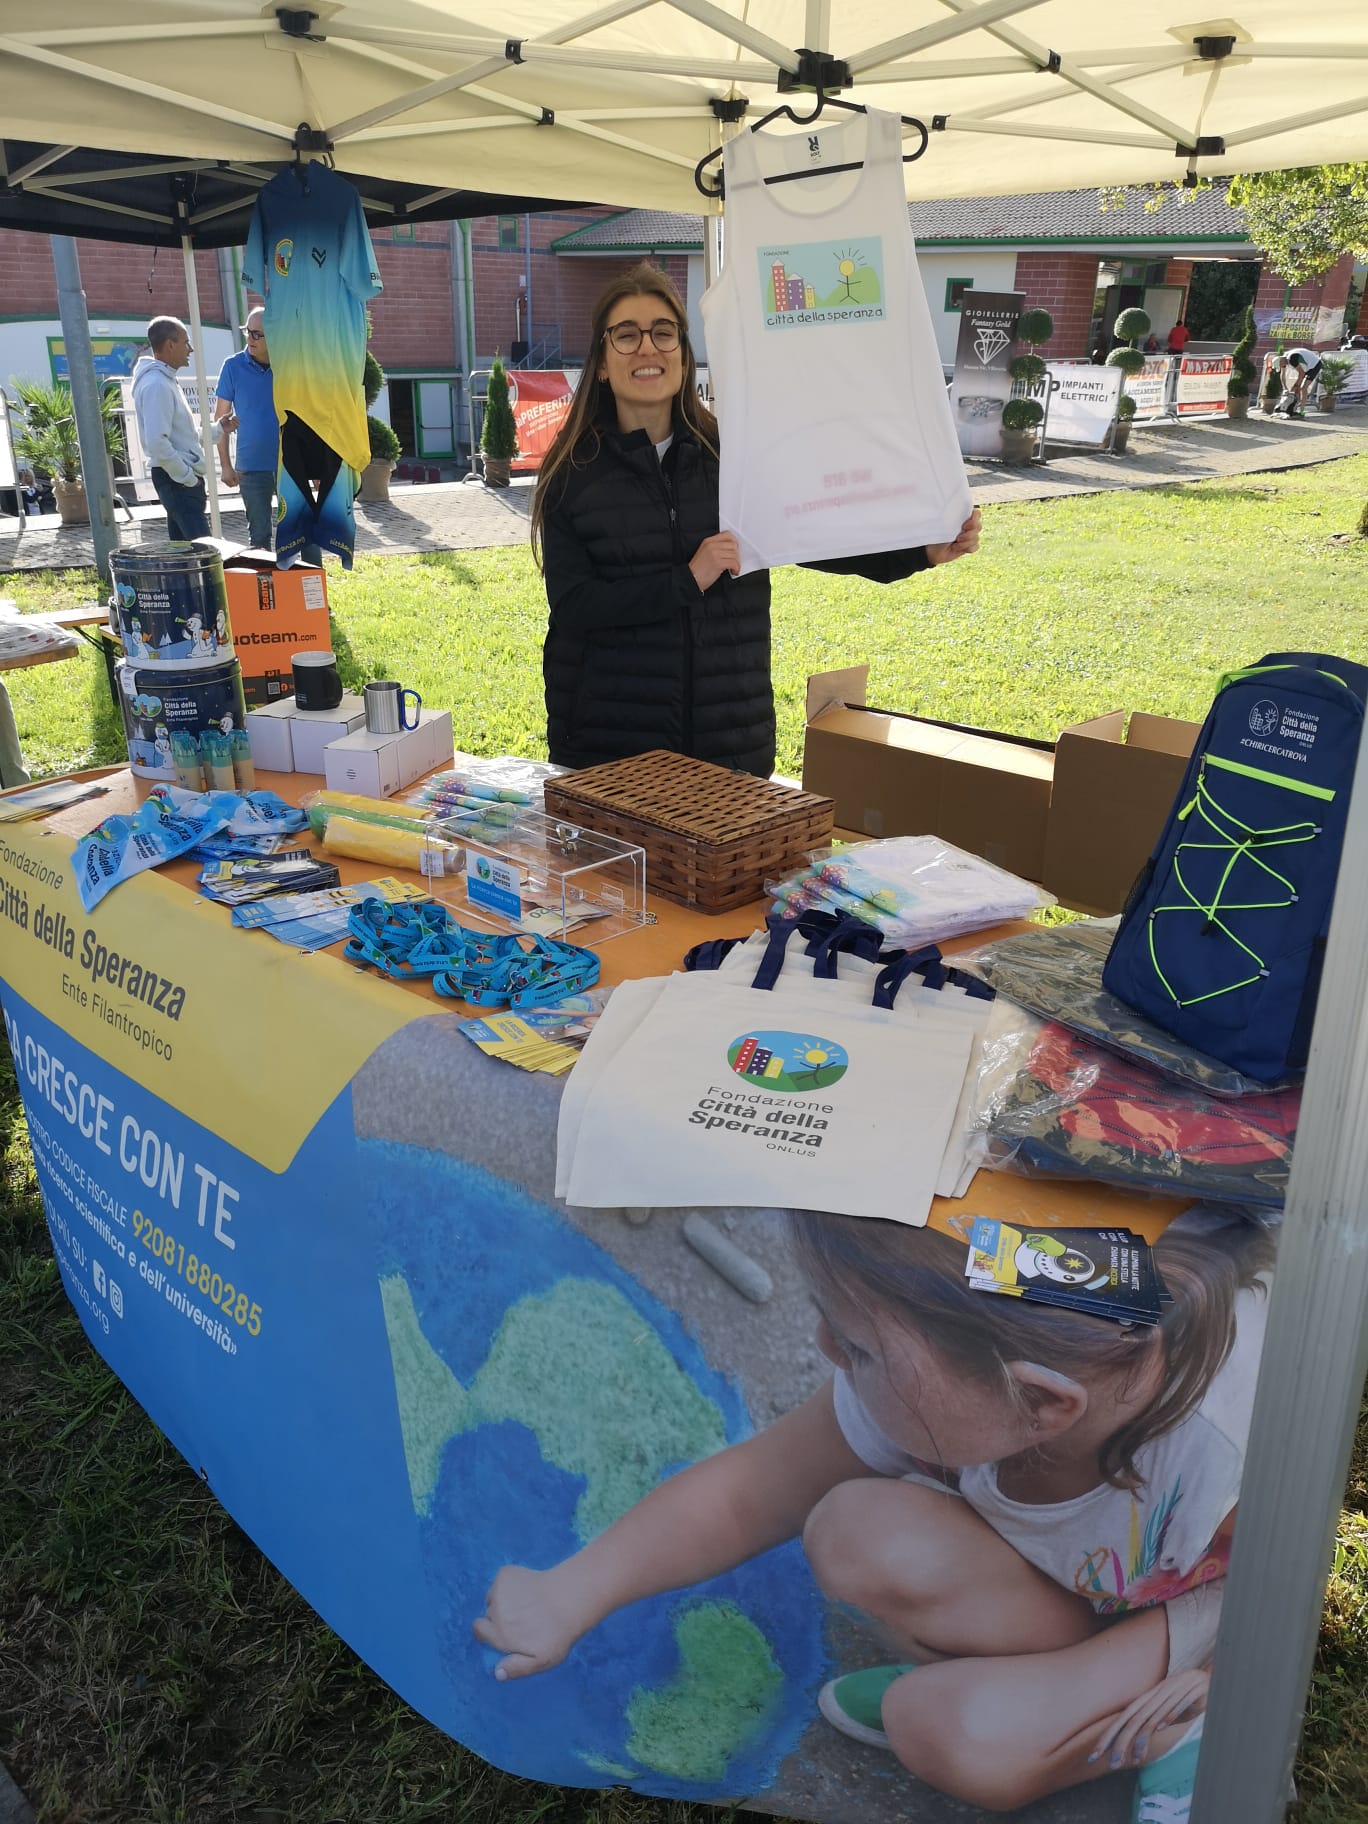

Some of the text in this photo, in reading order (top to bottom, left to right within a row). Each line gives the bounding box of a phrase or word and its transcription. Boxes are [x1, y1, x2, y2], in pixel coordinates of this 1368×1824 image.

[767, 308, 883, 326] città della speranza
[965, 309, 1020, 319] GIOIELLERIE
[970, 319, 1013, 328] Fantasy Gold
[1062, 380, 1104, 391] IMPIANTI
[1061, 392, 1108, 403] ELETTRICI
[138, 593, 169, 601] Città della
[139, 600, 171, 608] Speranza
[164, 701, 196, 710] Città della
[165, 708, 198, 717] Speranza
[1284, 708, 1320, 722] Fondazione
[1282, 716, 1318, 732] Città della
[1280, 726, 1316, 743] Speranza
[1240, 738, 1307, 763] #CHIRICERCATROVA
[33, 903, 76, 960] della
[80, 929, 187, 1021] Speranza
[62, 973, 173, 1061] Ente Filantropico
[707, 1086, 834, 1114] Fondazione
[698, 1099, 829, 1130] Città della
[688, 1110, 824, 1148] Speranza
[24, 1035, 115, 1156] CRESCE
[119, 1114, 185, 1209] CON
[194, 1163, 240, 1250] TE
[766, 1143, 817, 1158] ONLUS
[52, 1140, 87, 1189] CODICE
[87, 1176, 128, 1228] FISCALE
[132, 1209, 263, 1336] 92081880285
[75, 1196, 126, 1258] scientifica
[128, 1250, 137, 1267] e
